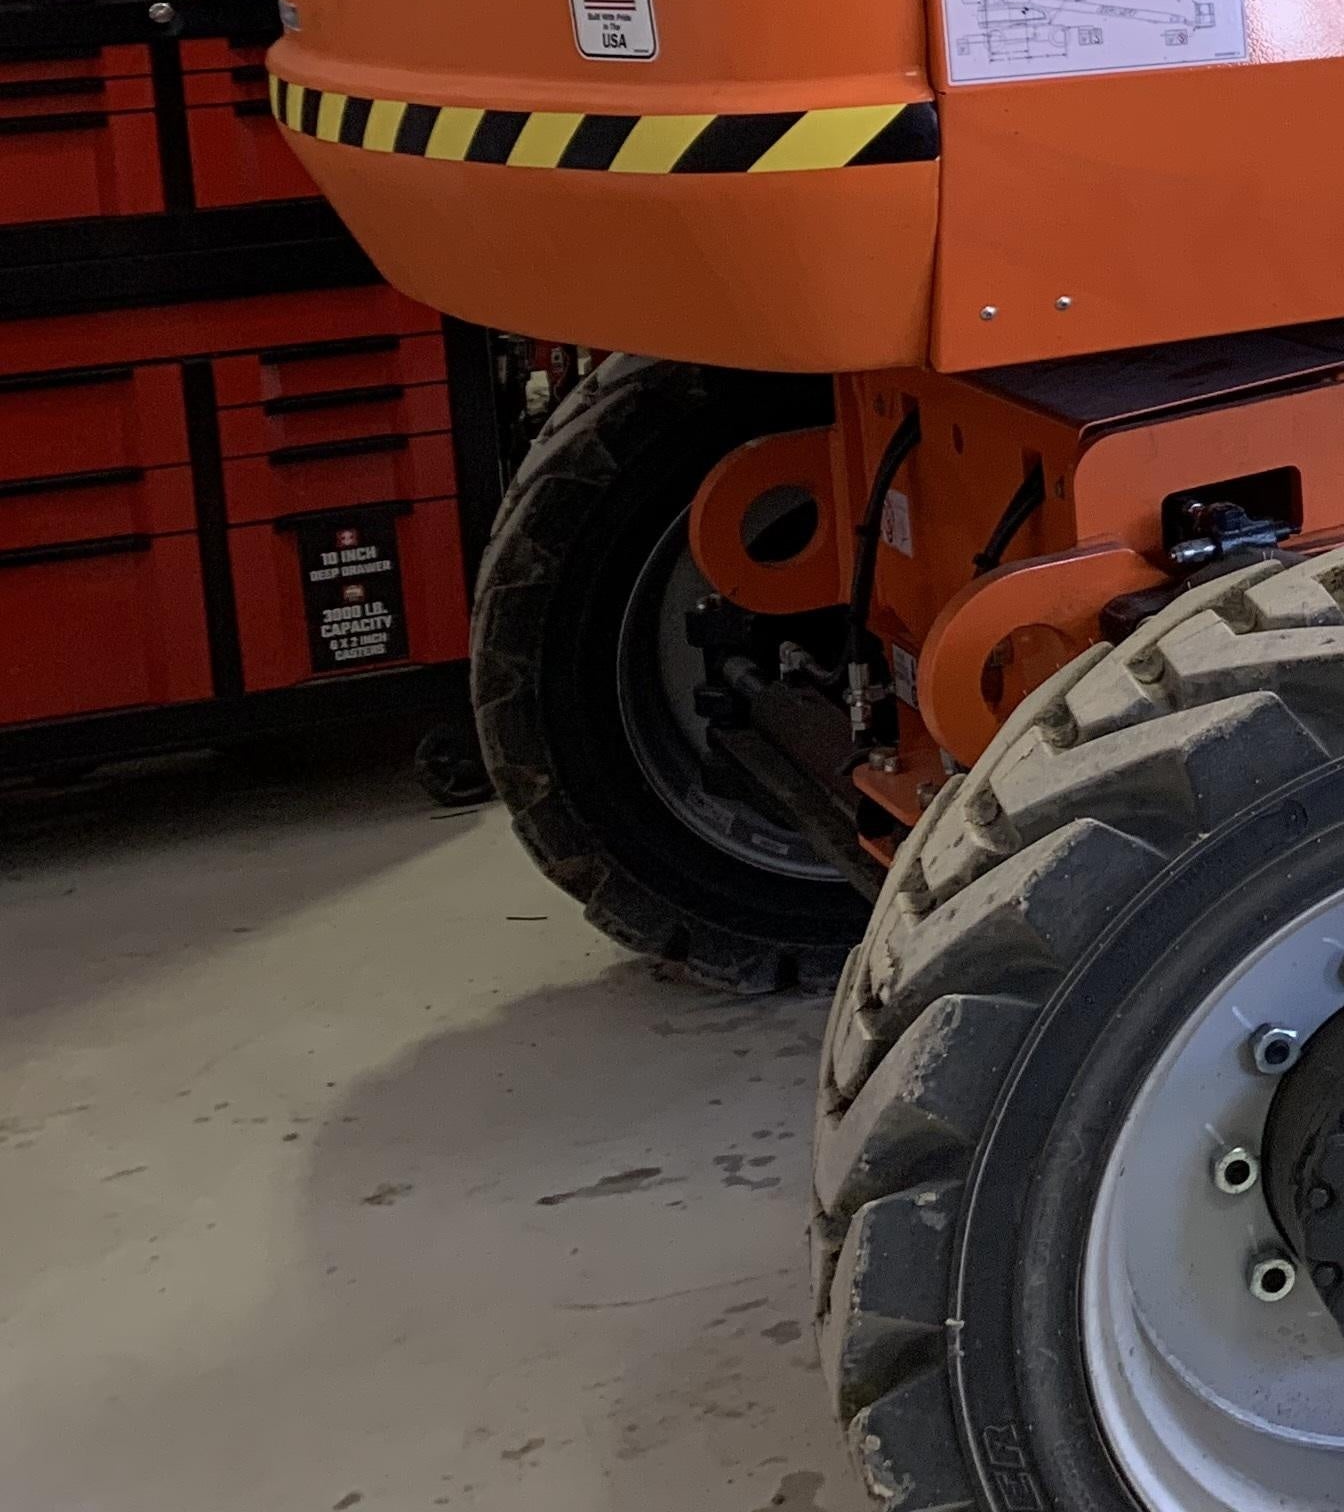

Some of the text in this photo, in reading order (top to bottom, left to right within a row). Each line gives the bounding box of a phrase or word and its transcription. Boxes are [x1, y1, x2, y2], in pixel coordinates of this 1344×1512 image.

[602, 33, 627, 48] USA
[320, 546, 378, 566] 10 INCH
[341, 560, 392, 577] DRAWER
[320, 615, 392, 638] CAPACITY
